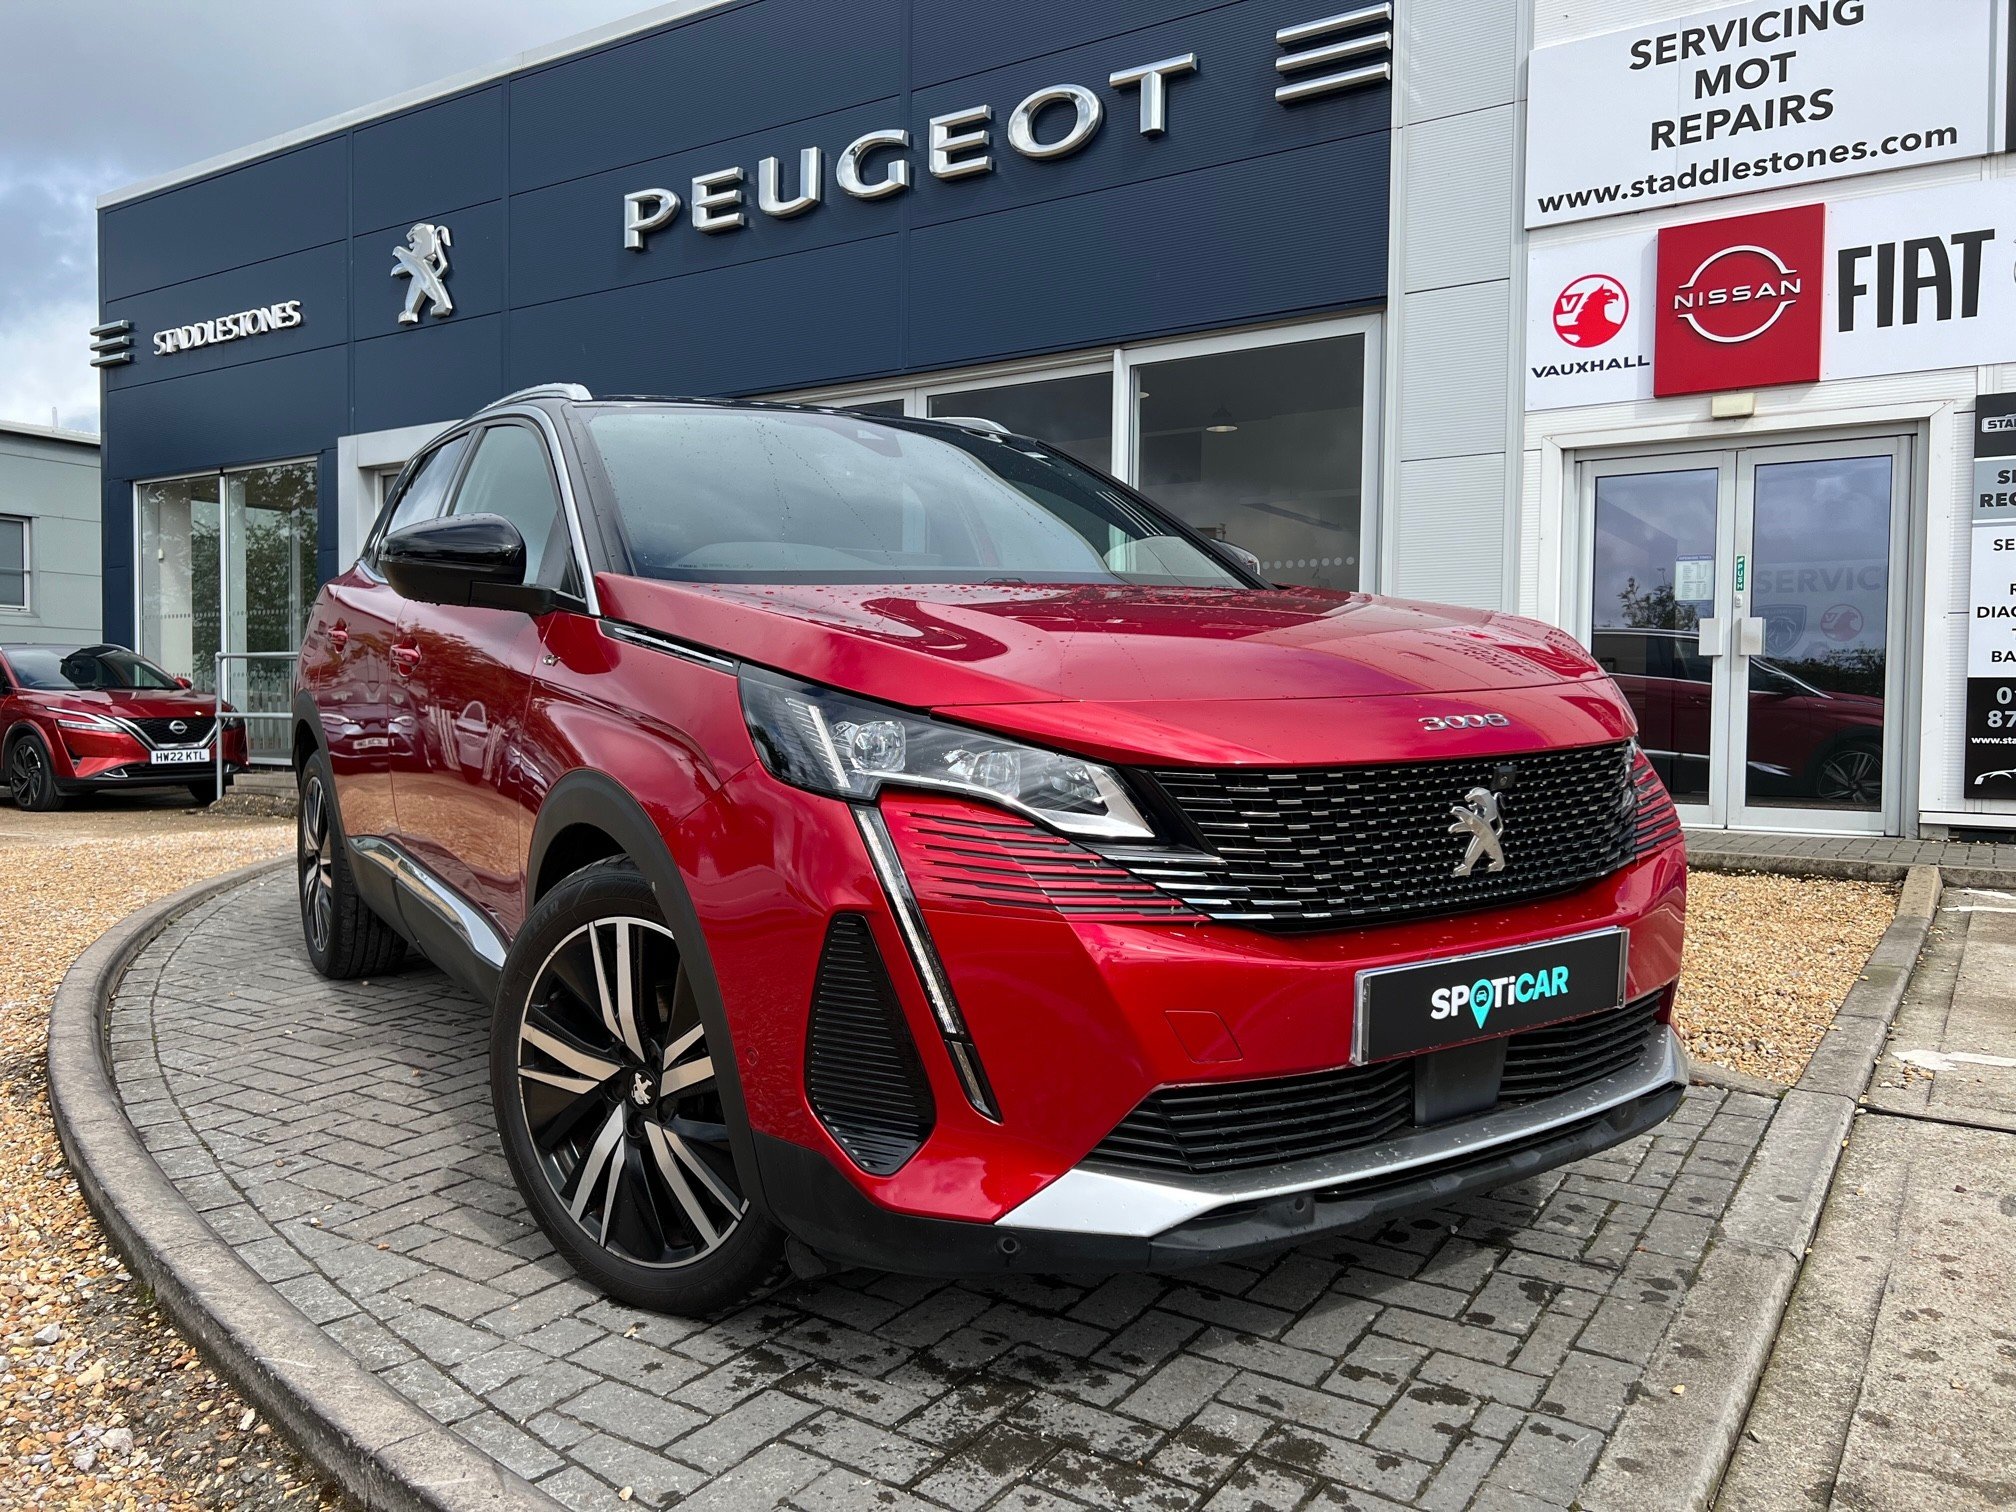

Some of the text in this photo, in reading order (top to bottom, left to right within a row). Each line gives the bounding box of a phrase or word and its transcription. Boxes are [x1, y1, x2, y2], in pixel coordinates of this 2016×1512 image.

[1629, 0, 1865, 70] SERVICING
[1694, 51, 1797, 100] MOT
[1651, 88, 1834, 151] REPAIRS
[623, 52, 1197, 251] PEUGEOT
[1537, 126, 1958, 213] www.staddlestones.com
[1673, 278, 1801, 310] NISSAN
[1837, 228, 1996, 333] FIAT
[153, 300, 302, 356] STADDLESTONES
[1531, 355, 1650, 378] VAUXHALL
[1418, 713, 1510, 732] 3008
[155, 751, 206, 762] HW22 KTL
